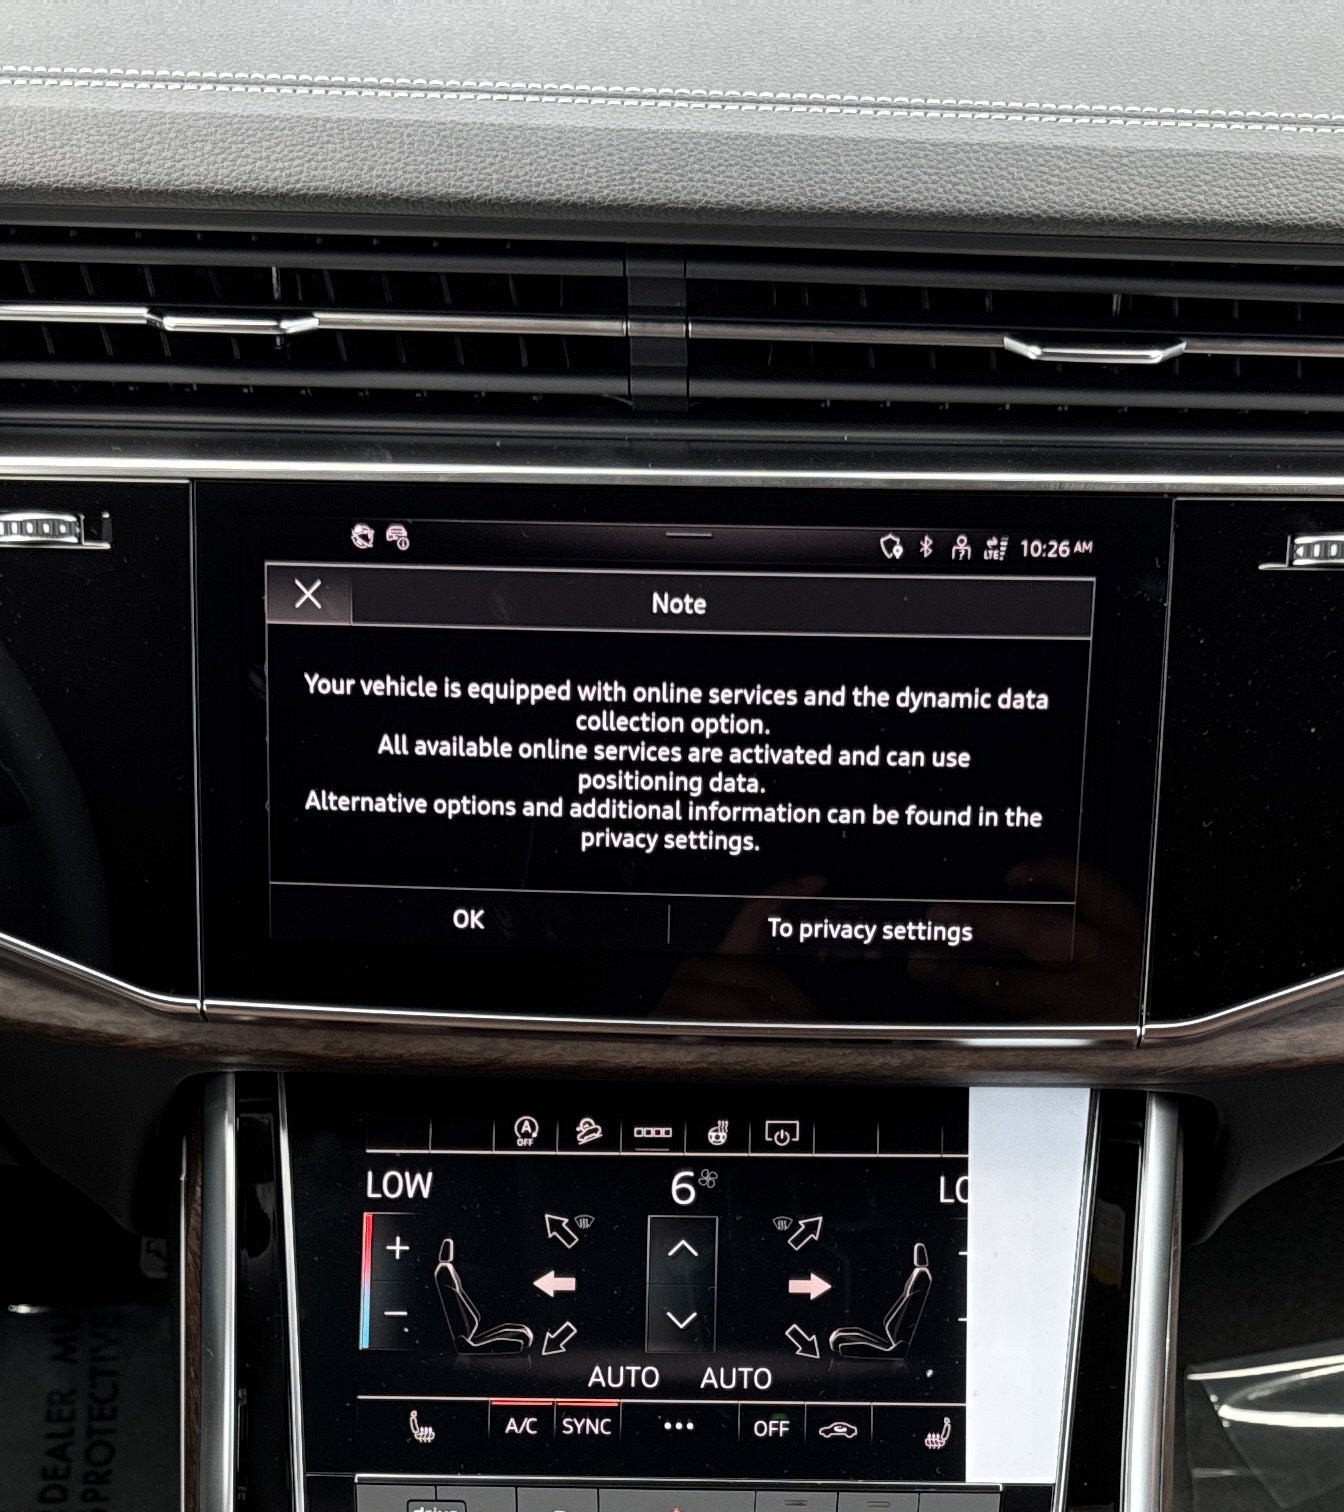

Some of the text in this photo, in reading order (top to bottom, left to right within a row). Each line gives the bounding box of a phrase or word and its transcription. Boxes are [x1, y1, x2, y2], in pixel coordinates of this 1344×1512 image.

[1021, 539, 1094, 558] 10:26 AM
[653, 592, 706, 614] Note
[304, 672, 1048, 713] Your vehicle is equipped with online services and the dynamic data
[576, 710, 770, 739] collection option.
[378, 734, 970, 767] All available online services are activated and can use
[579, 770, 765, 797] positioning data.
[305, 790, 1042, 827] Alternative options and additional information can be found in the
[582, 828, 759, 855] privacy settings.
[453, 909, 484, 929] OK
[768, 918, 972, 946] To privacy settings
[517, 1138, 534, 1146] OFF
[367, 1171, 432, 1198] LOW
[670, 1170, 698, 1206] 6
[588, 1366, 771, 1389] AUTO AUTO
[80, 1310, 121, 1504] PROTECTIVE
[505, 1418, 537, 1434] A/C
[563, 1418, 611, 1434] SYNC
[754, 1418, 790, 1439] OFF
[37, 1389, 78, 1505] DEALER
